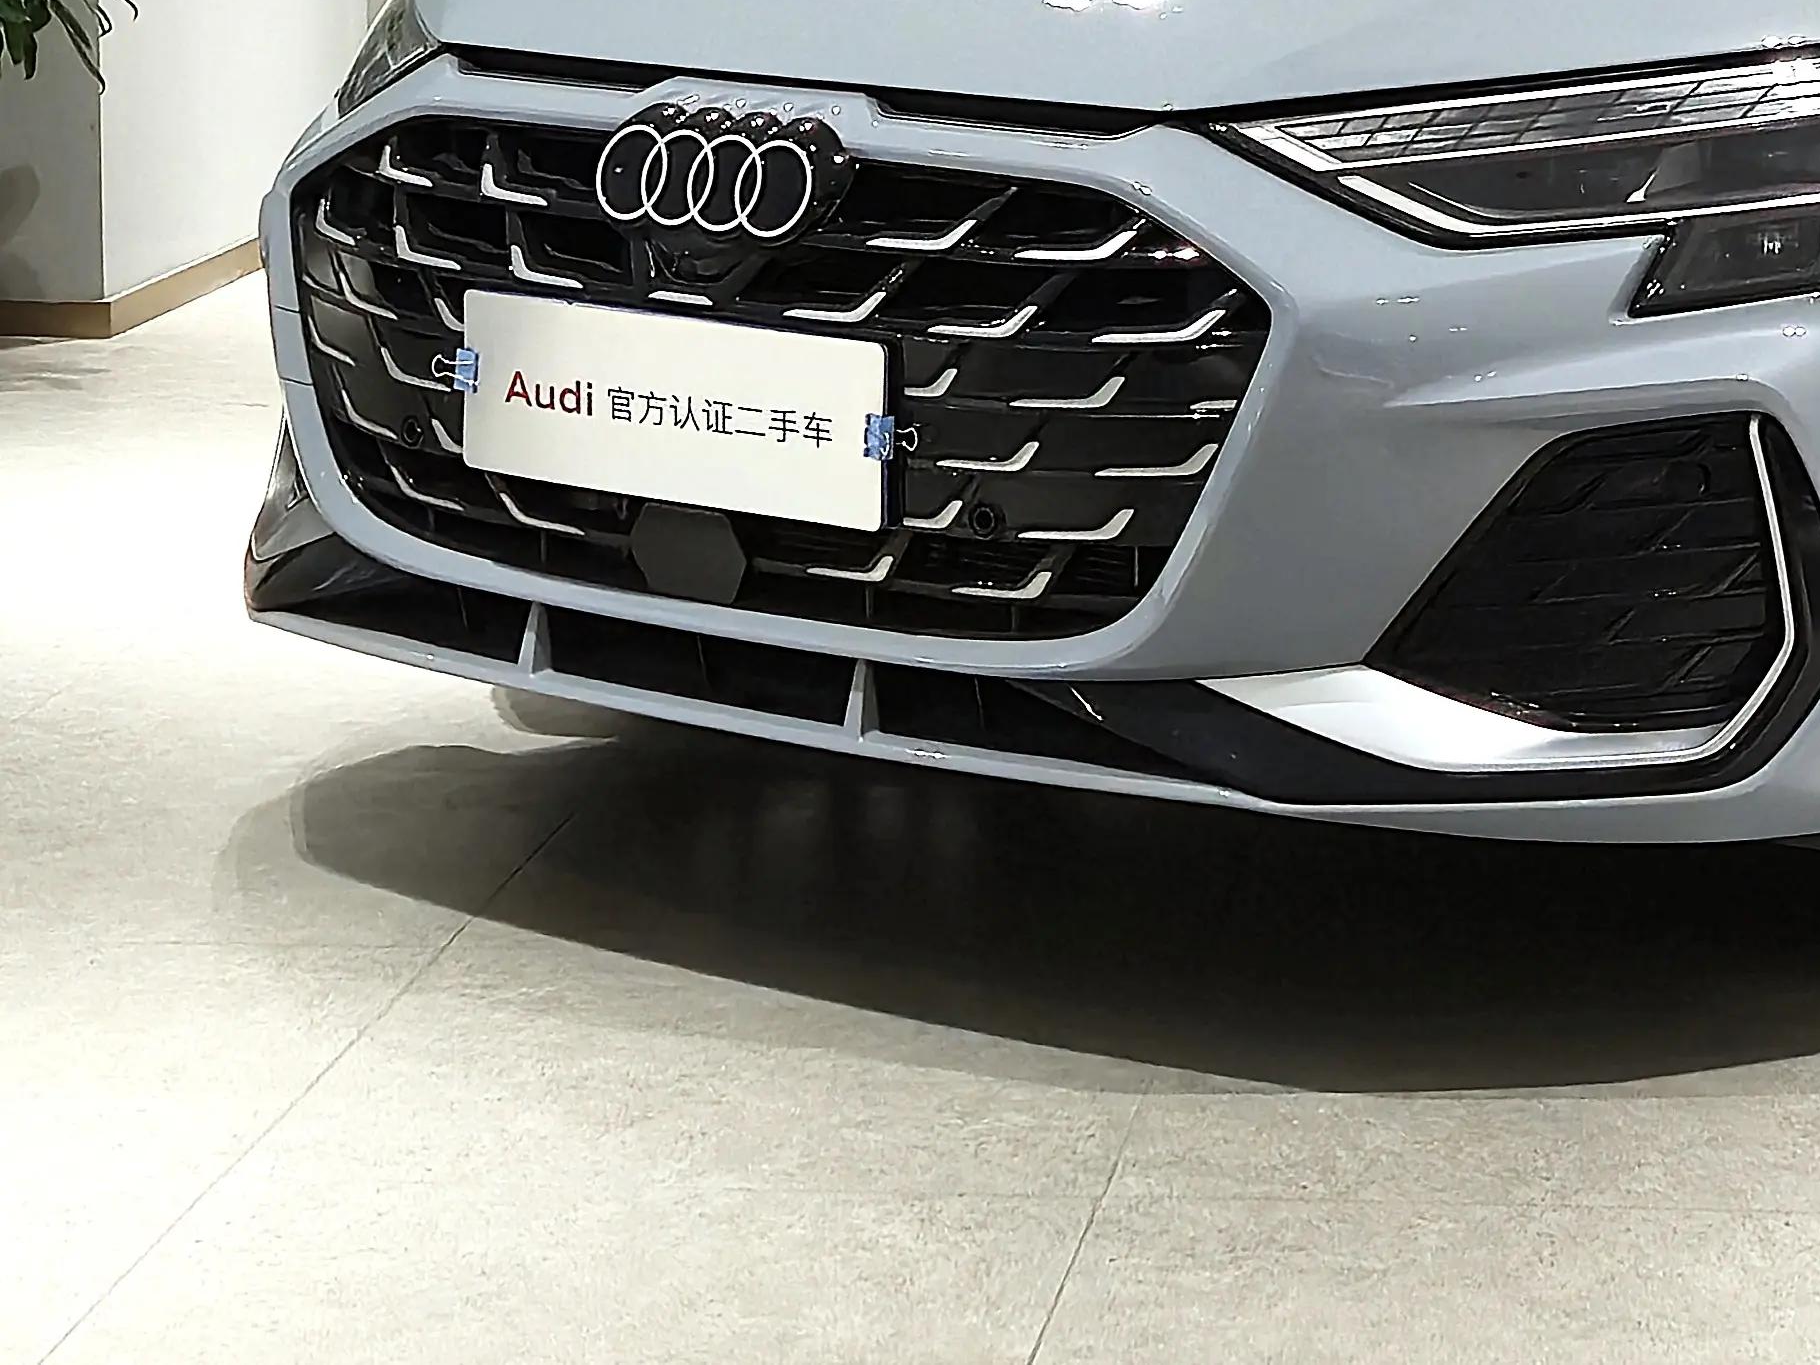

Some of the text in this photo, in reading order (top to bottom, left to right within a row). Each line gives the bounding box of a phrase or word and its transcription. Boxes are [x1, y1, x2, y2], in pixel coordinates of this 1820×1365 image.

[505, 371, 832, 447] Audi 官方认证二手车
